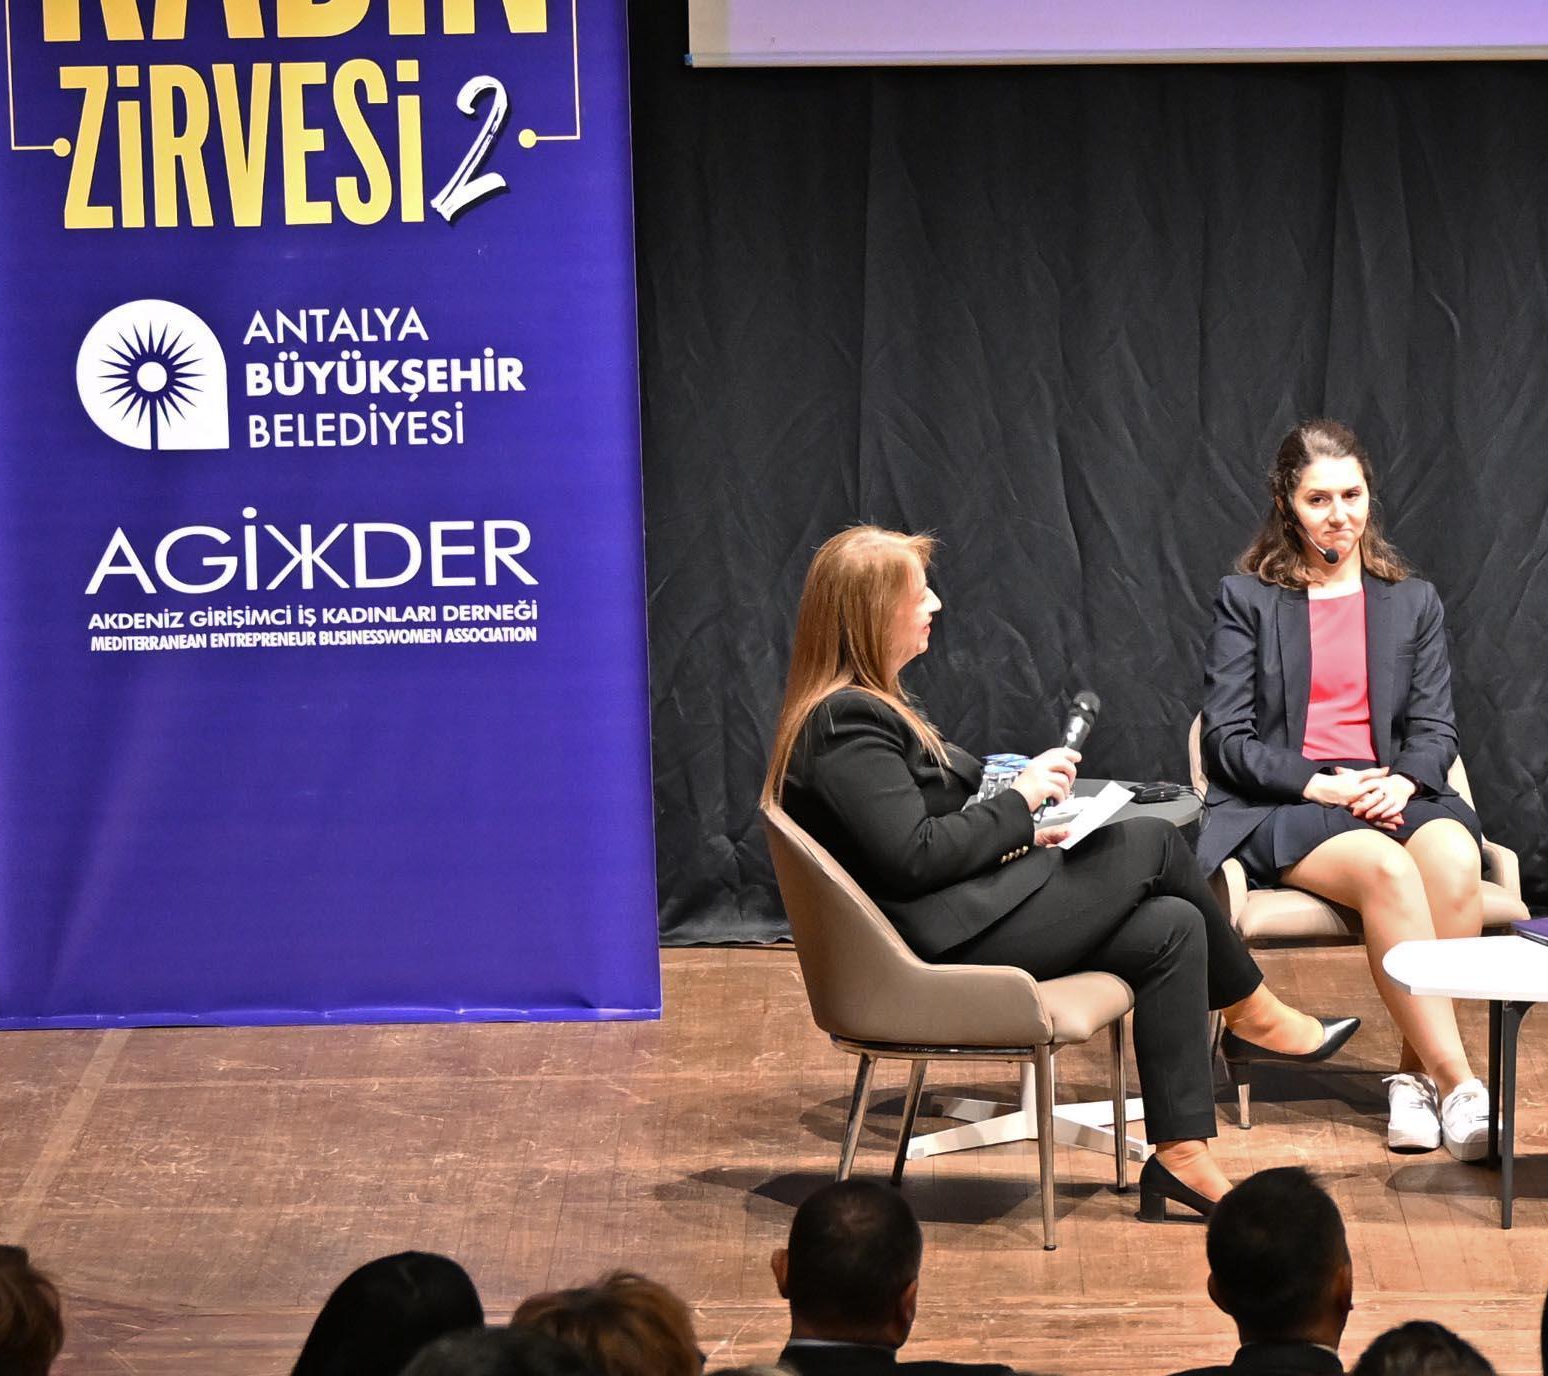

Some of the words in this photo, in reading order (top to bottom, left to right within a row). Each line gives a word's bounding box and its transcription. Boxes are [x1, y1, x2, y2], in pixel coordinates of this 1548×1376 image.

[59, 59, 424, 228] ZİRVESİ
[430, 74, 508, 222] 2
[243, 306, 429, 344] ANTALYA
[245, 347, 527, 401] BÜYÜKŞEHİR
[248, 402, 464, 448] BELEDİYESİ
[88, 607, 185, 630] AKDENİZ
[189, 605, 291, 630] GİRİŞİMCİ
[297, 605, 317, 627] İŞ
[322, 605, 437, 624] KADINLARI
[442, 600, 538, 622] DERNEĞİ
[91, 633, 207, 652] MEDITERRANEAN
[210, 631, 316, 649] ENTREPRENEUR
[319, 628, 442, 646] BUSINESSWOMEN
[445, 626, 537, 643] ASSOCIATION
